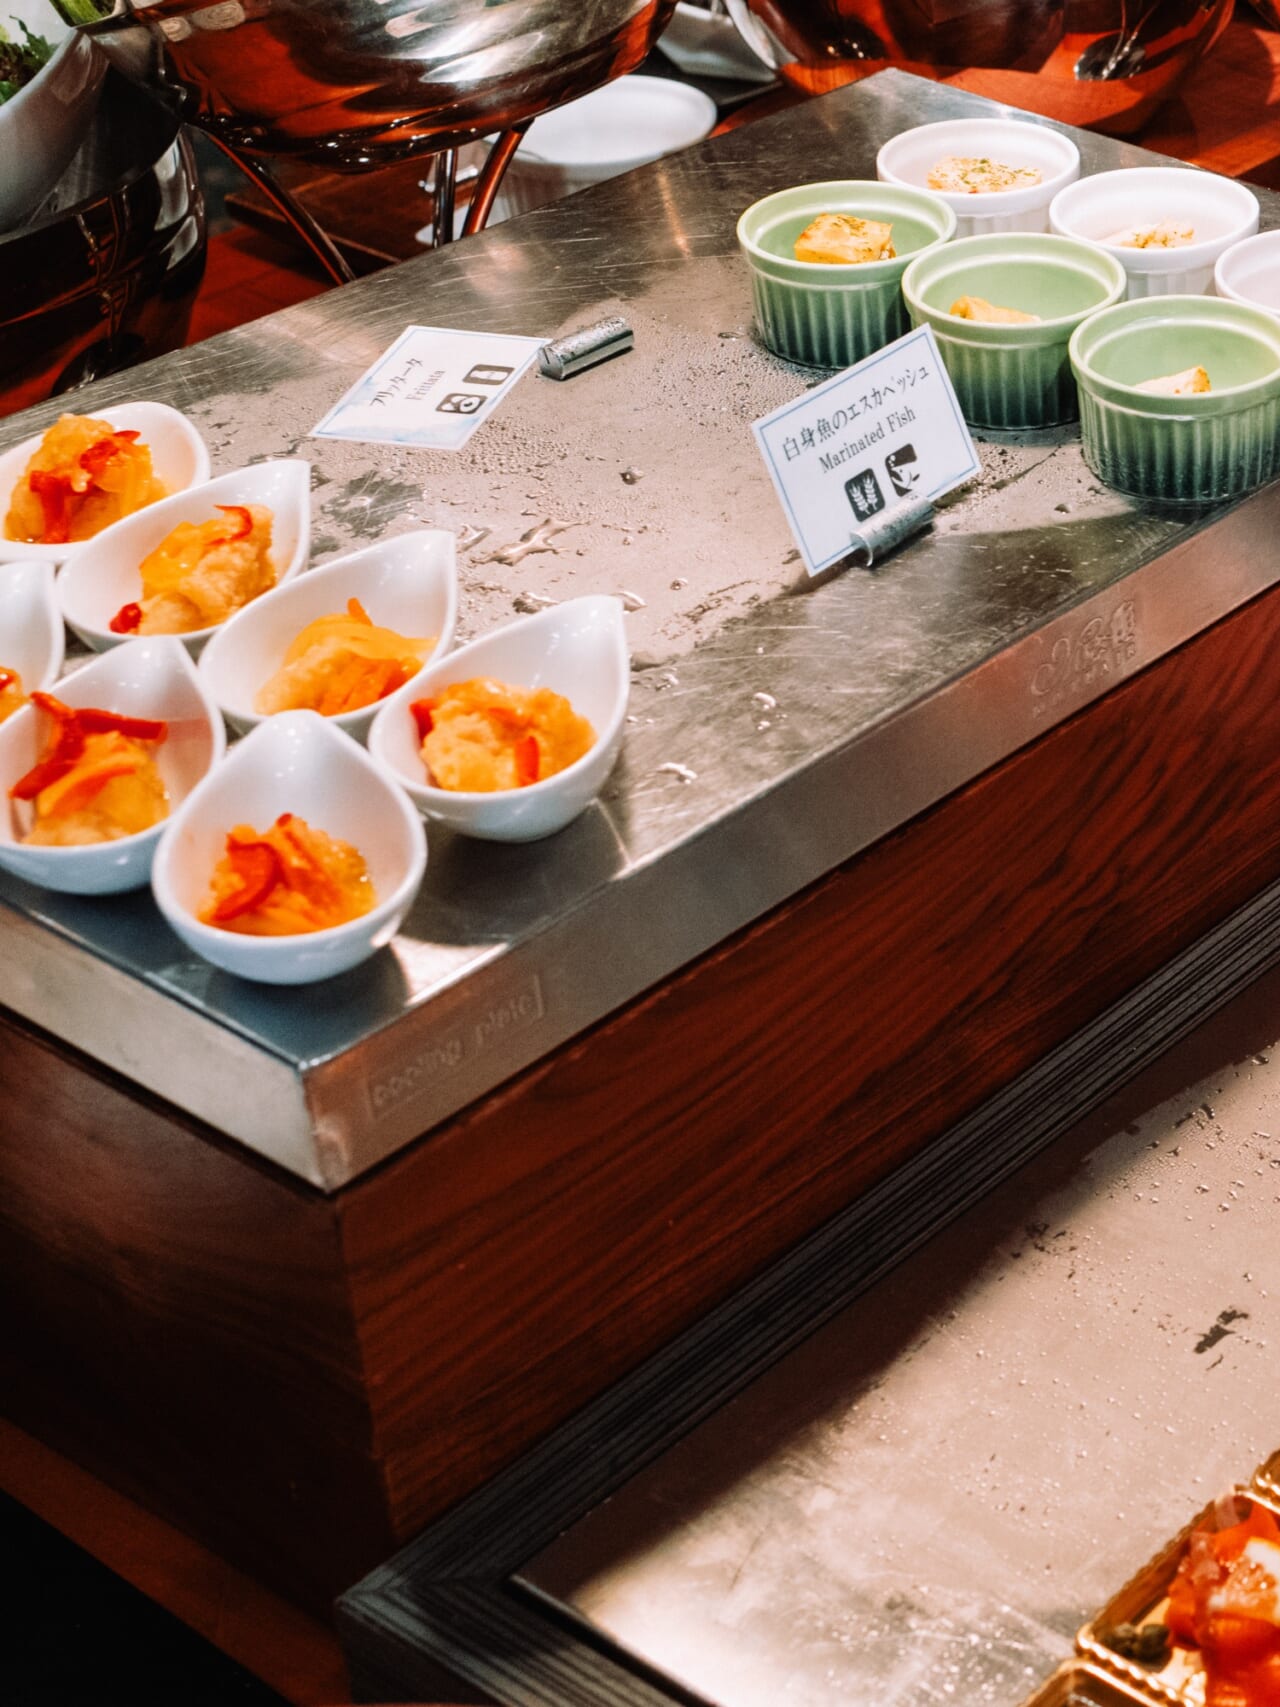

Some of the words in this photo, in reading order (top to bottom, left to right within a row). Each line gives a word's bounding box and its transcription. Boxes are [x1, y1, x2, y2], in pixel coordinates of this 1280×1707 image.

[369, 358, 423, 406] フリッタータ
[404, 370, 446, 401] Frittata
[782, 366, 929, 462] 白身魚のエスカベッシュ
[818, 422, 886, 474] Marinated
[886, 405, 917, 434] Fish
